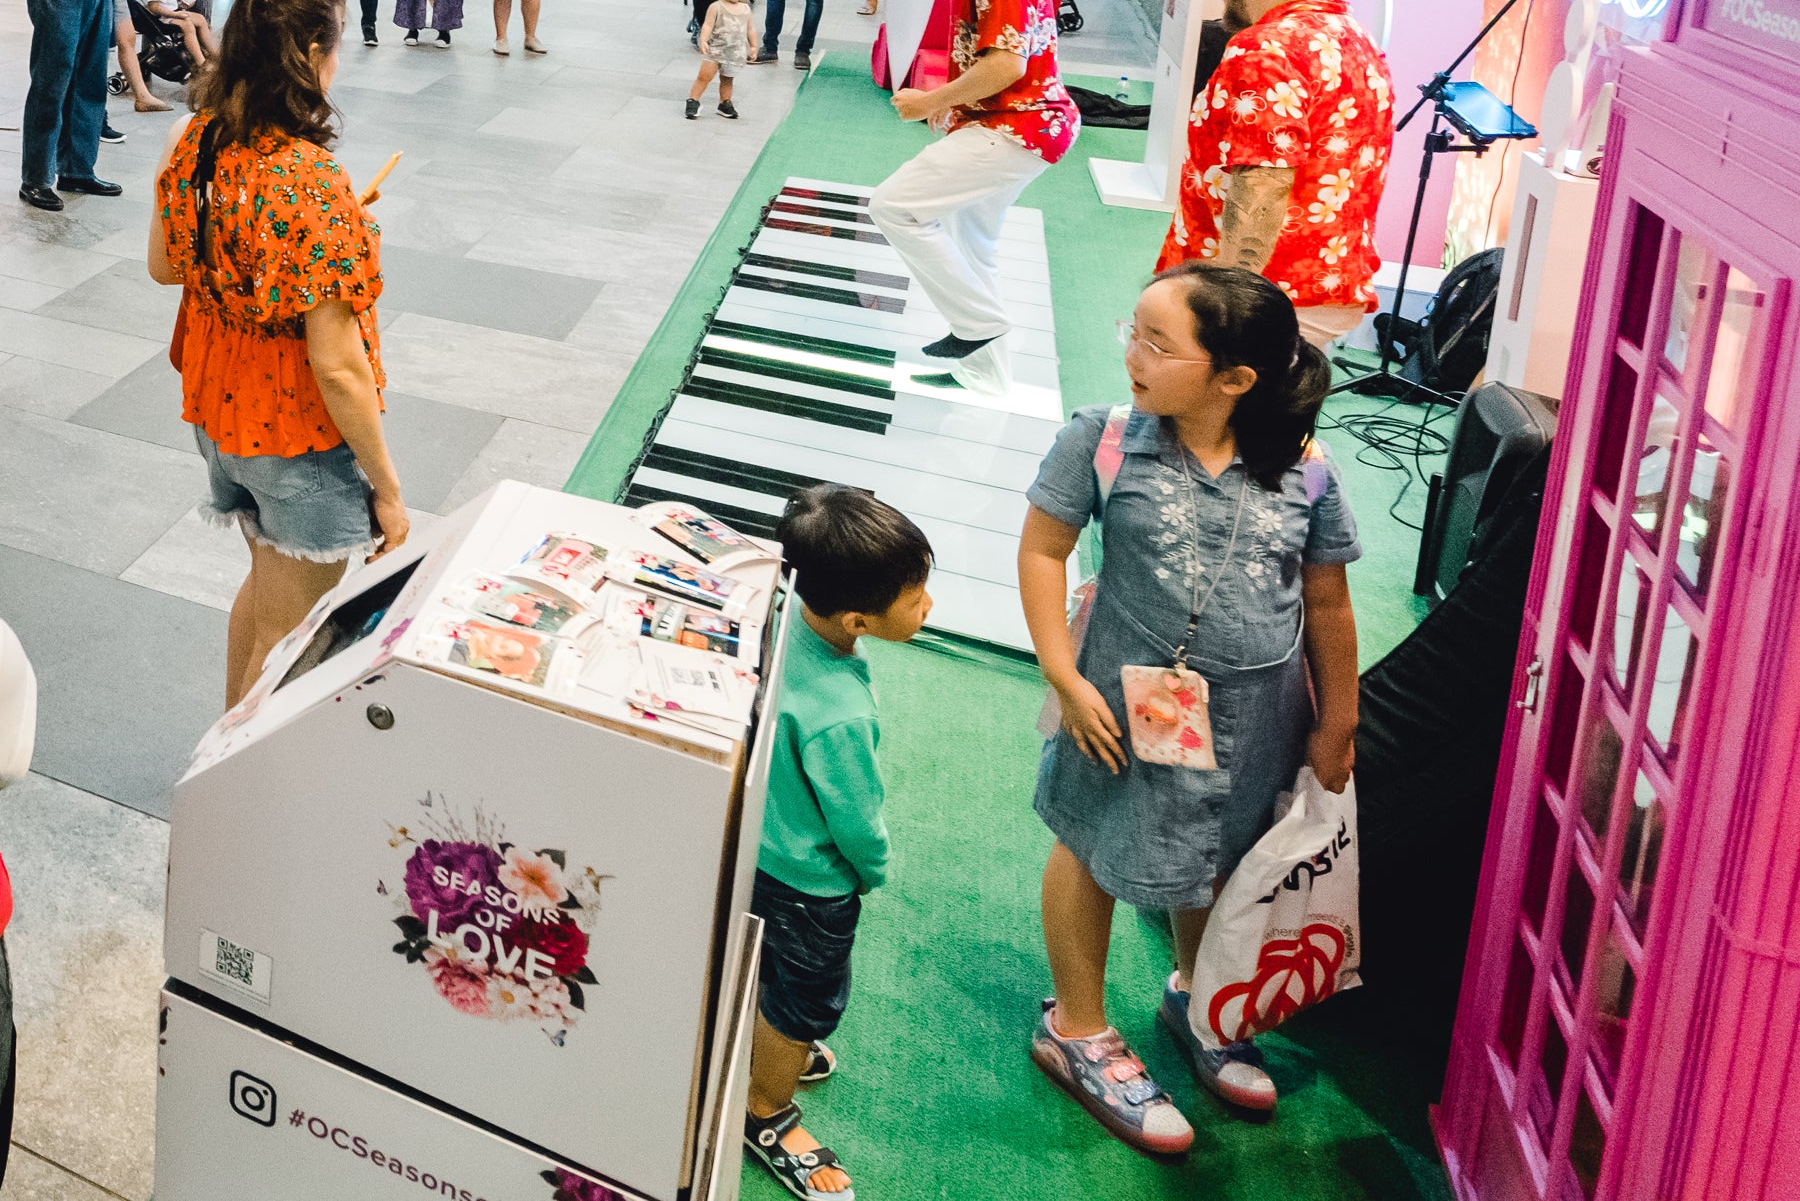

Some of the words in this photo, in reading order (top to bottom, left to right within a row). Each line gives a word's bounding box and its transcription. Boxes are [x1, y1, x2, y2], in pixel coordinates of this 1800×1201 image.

[433, 865, 560, 925] SEASONS
[475, 908, 513, 932] OF
[427, 909, 556, 982] LOVE
[289, 1108, 487, 1201] #OCSeasons
